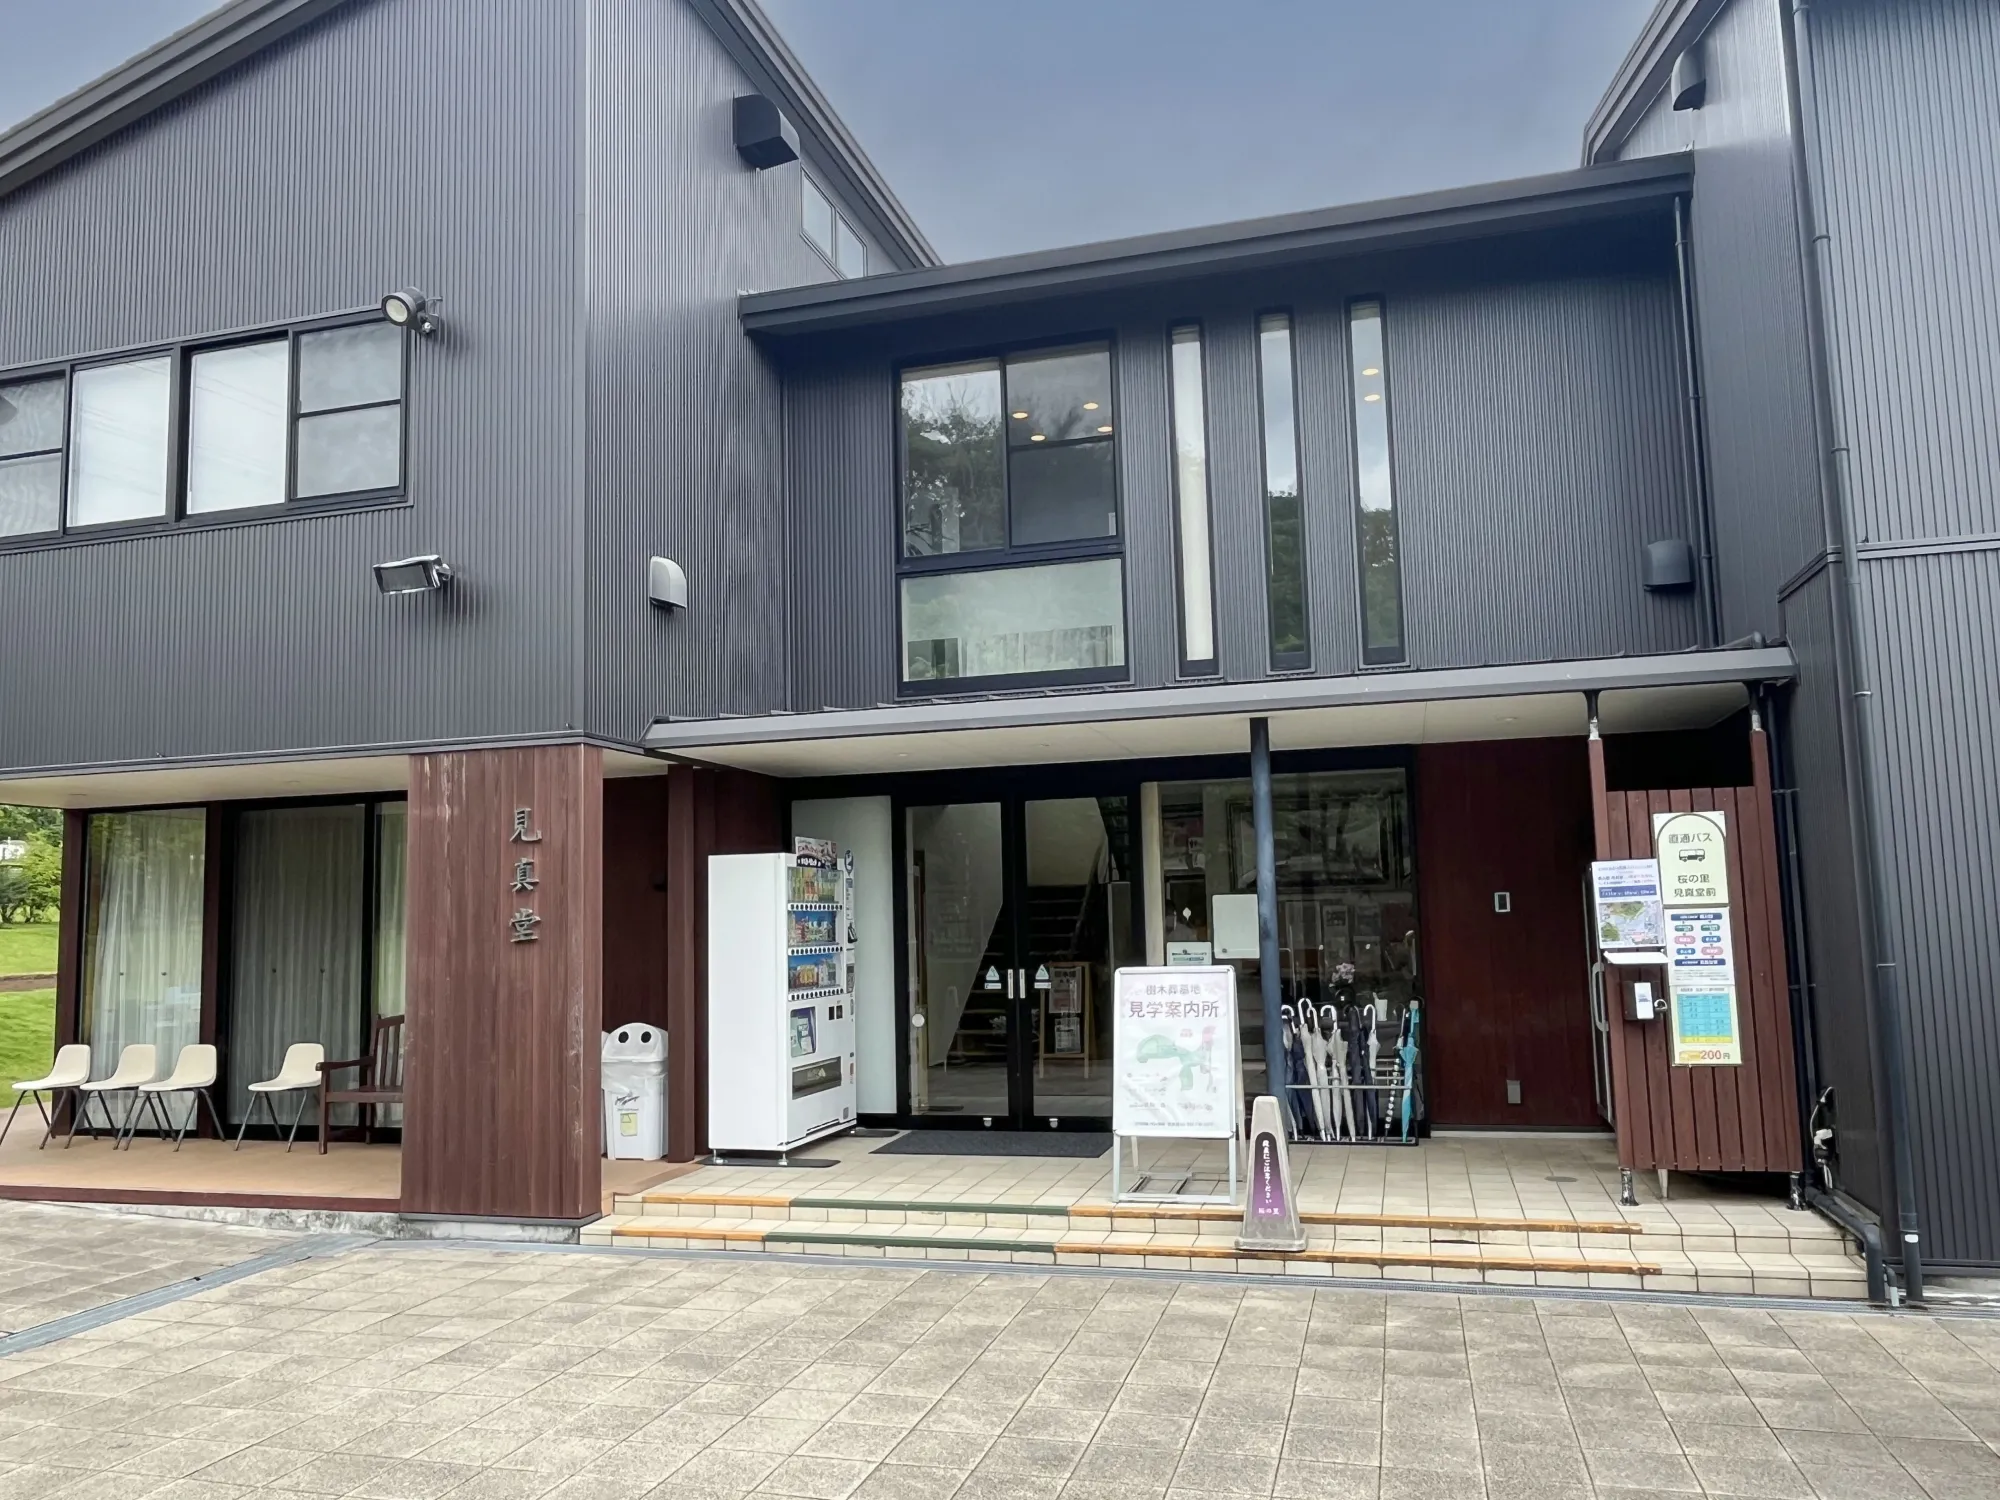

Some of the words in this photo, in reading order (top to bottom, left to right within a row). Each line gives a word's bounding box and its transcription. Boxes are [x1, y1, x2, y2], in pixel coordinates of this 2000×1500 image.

[1668, 832, 1713, 844] 直通バス
[509, 807, 542, 942] 見真堂
[1129, 1000, 1219, 1018] 見学案内所
